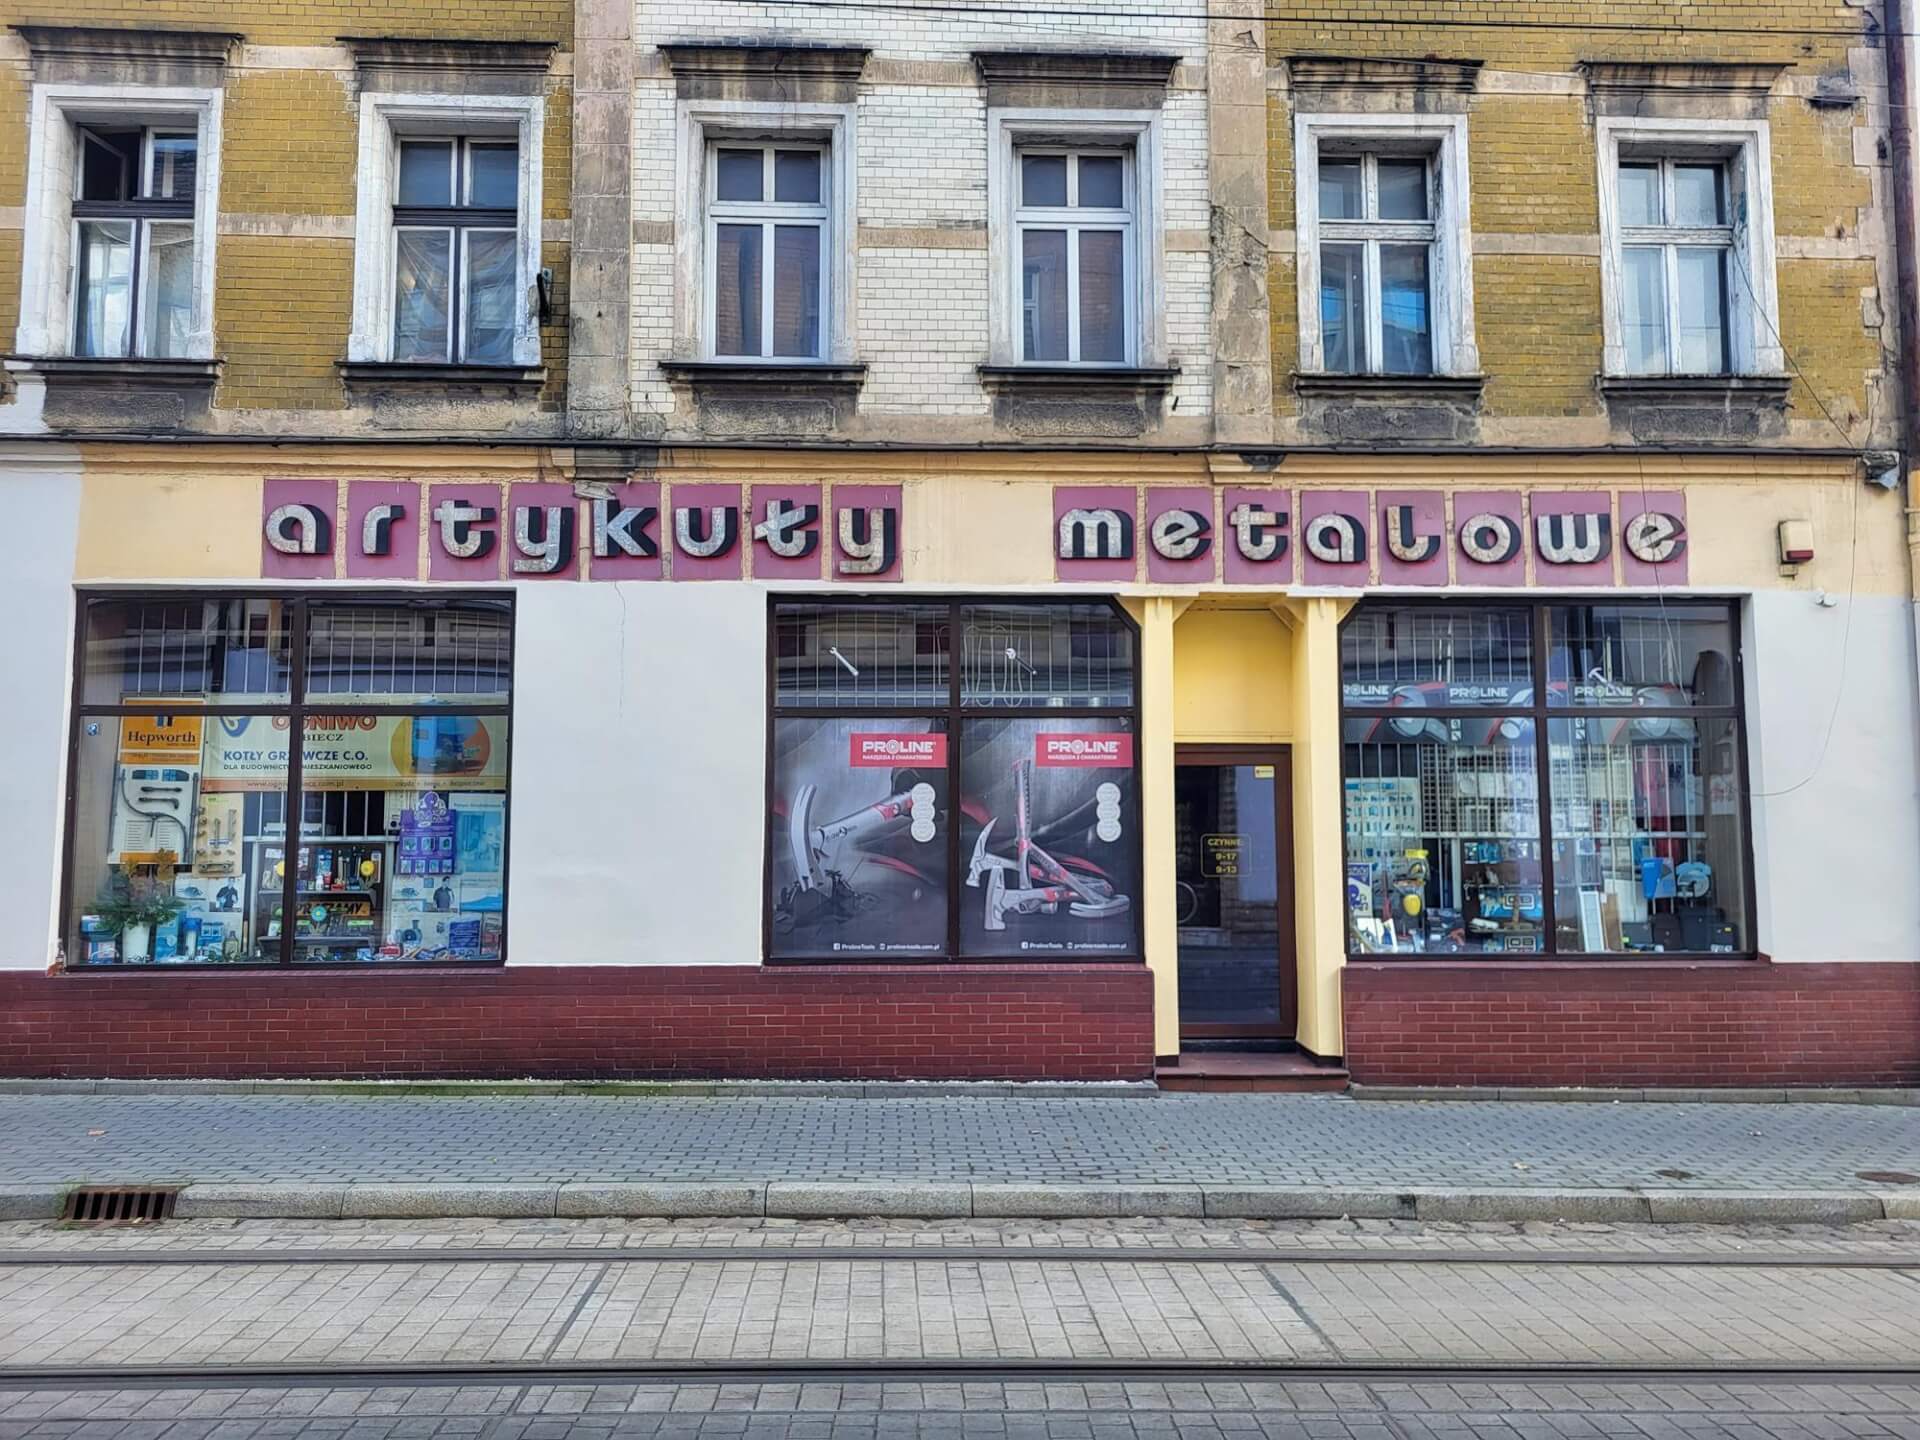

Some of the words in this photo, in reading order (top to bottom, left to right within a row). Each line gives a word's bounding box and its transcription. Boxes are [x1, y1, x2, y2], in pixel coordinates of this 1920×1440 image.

[1058, 503, 1688, 564] metalowe
[1343, 684, 1389, 695] ROLINE
[1450, 686, 1509, 698] PROLINE
[1574, 685, 1633, 697] PROLINE
[127, 731, 196, 746] Hepworth
[862, 740, 935, 754] PROLINE
[1047, 740, 1119, 754] PROLINE
[223, 751, 264, 761] KOTŁY
[268, 751, 339, 761] GRWCZE
[343, 751, 368, 761] C.O.
